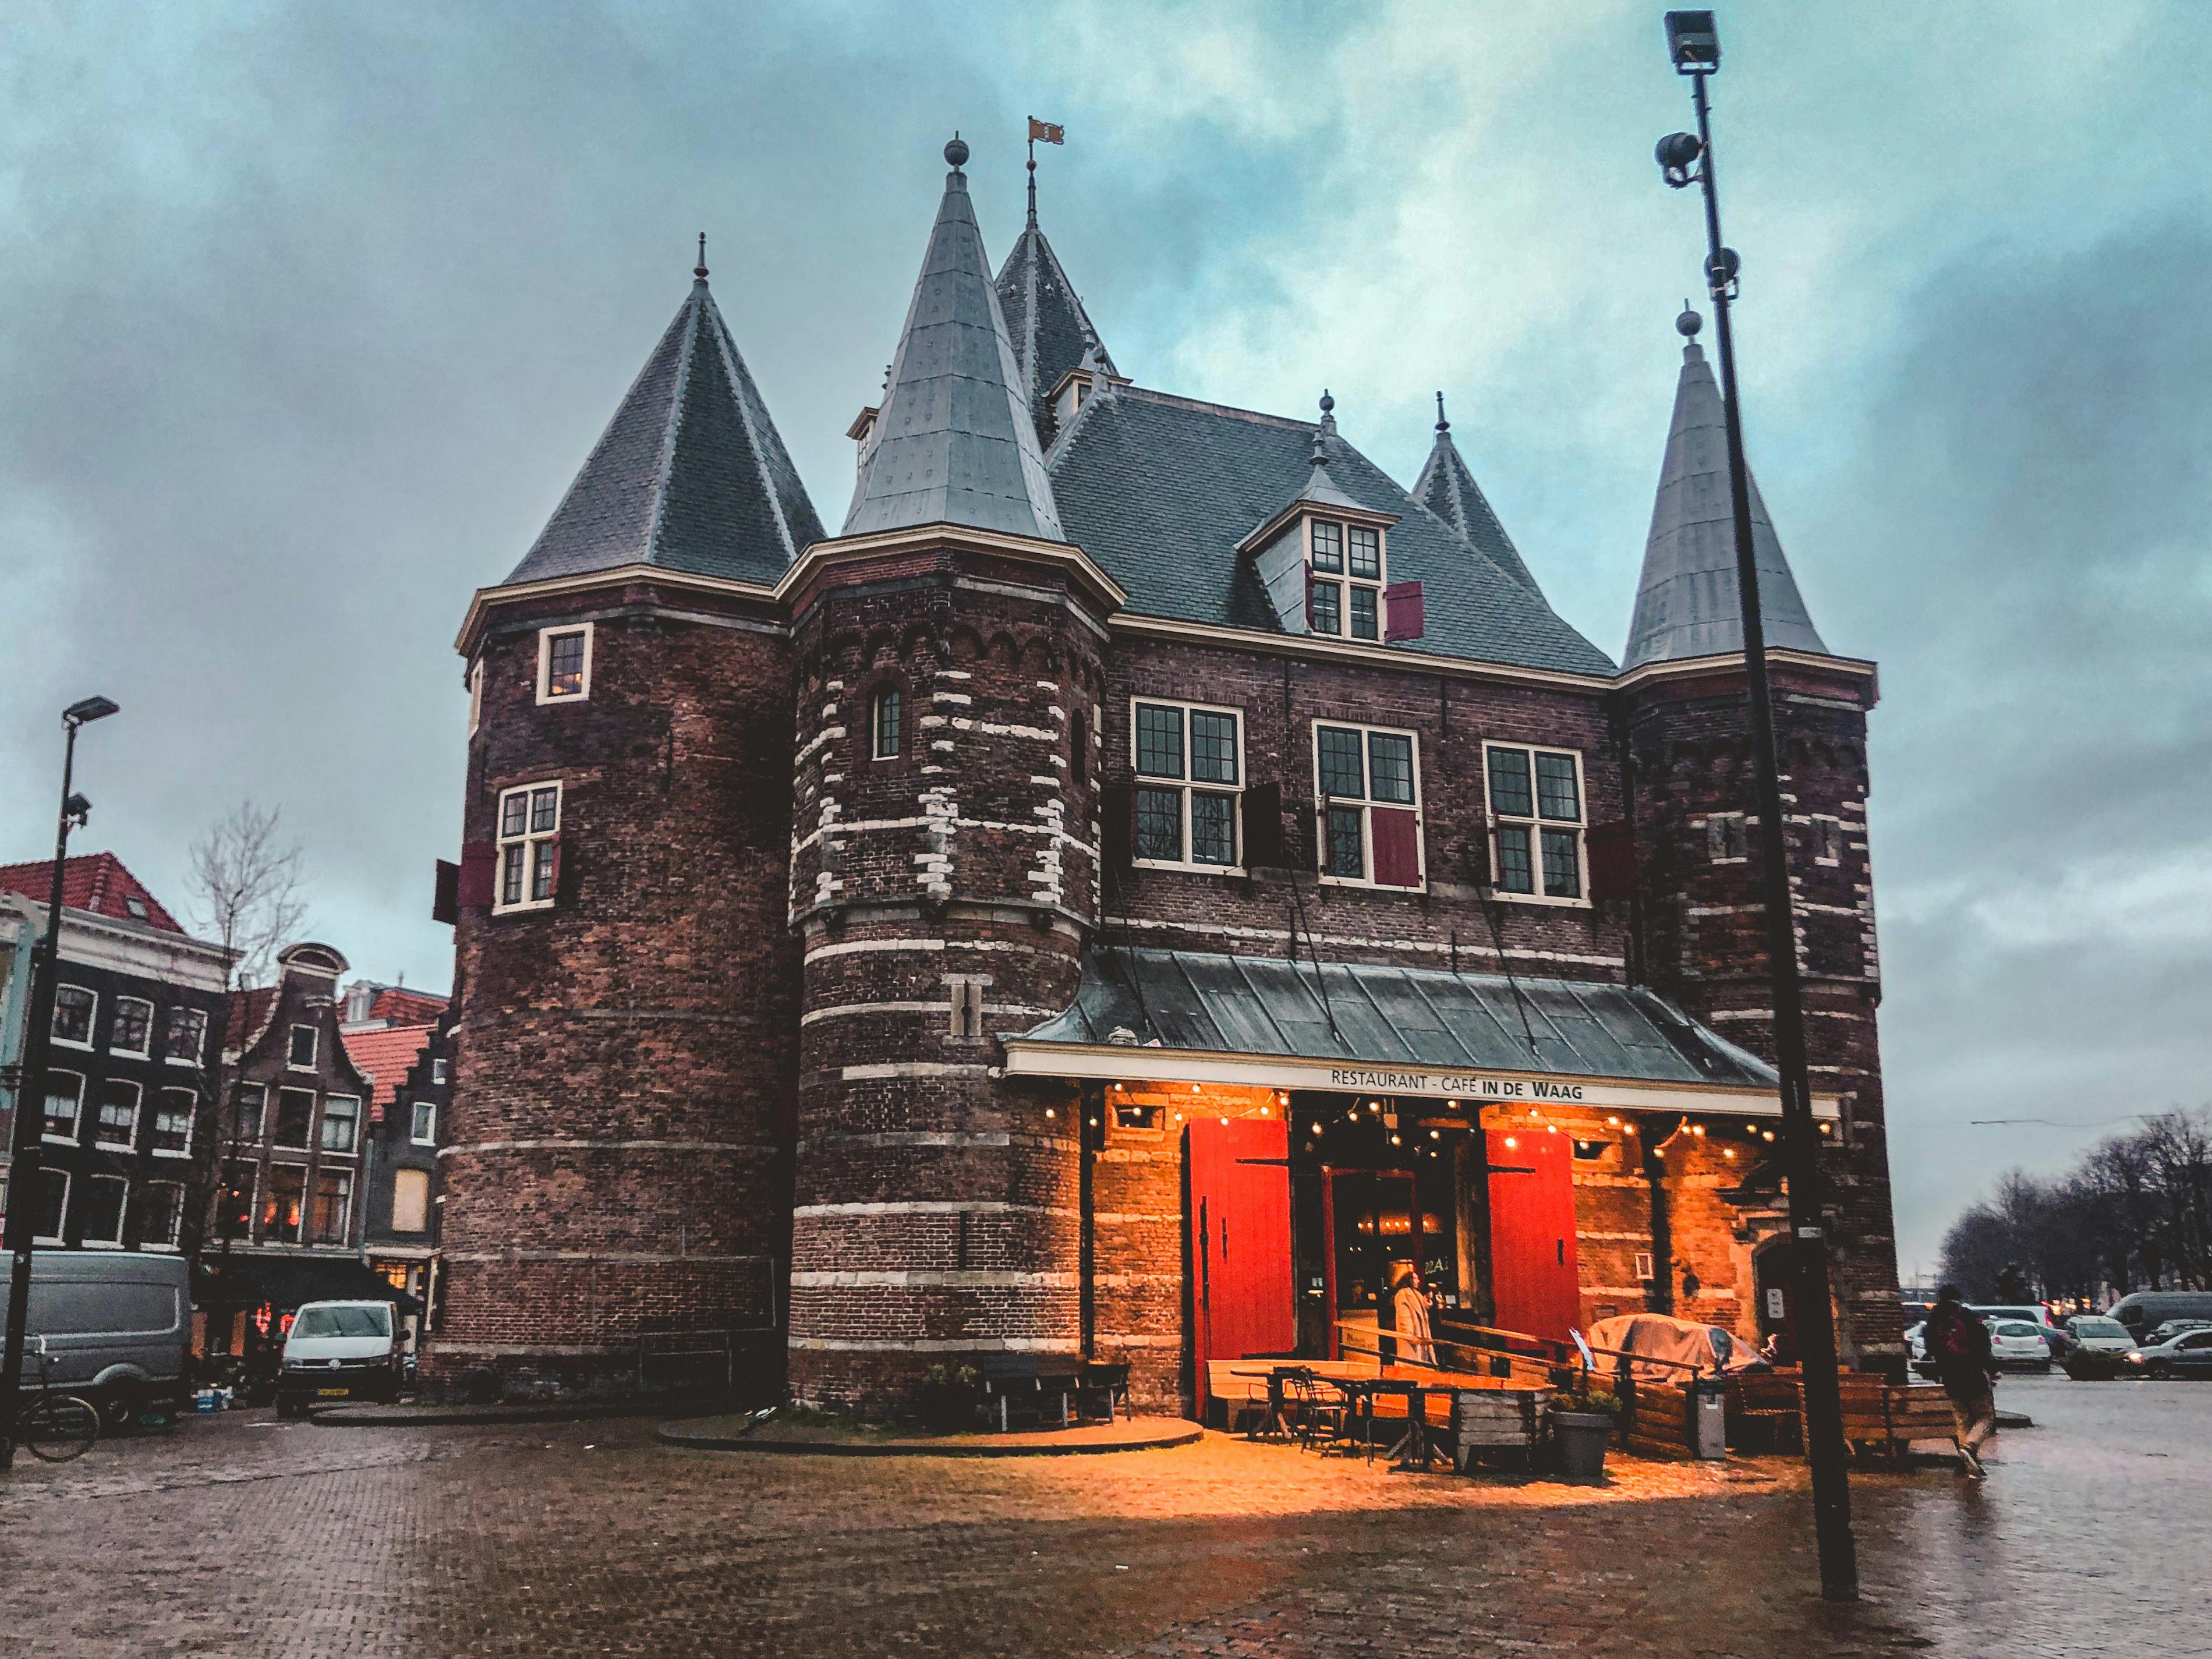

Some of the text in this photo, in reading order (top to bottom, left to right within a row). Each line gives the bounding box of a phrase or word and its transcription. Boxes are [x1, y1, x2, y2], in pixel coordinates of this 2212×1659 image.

[1332, 1070, 1428, 1089] RESTAURANT
[1442, 1076, 1477, 1092] CAFÉ
[1482, 1080, 1498, 1095] IN
[1503, 1082, 1523, 1096] DE
[1531, 1081, 1582, 1099] WAAG
